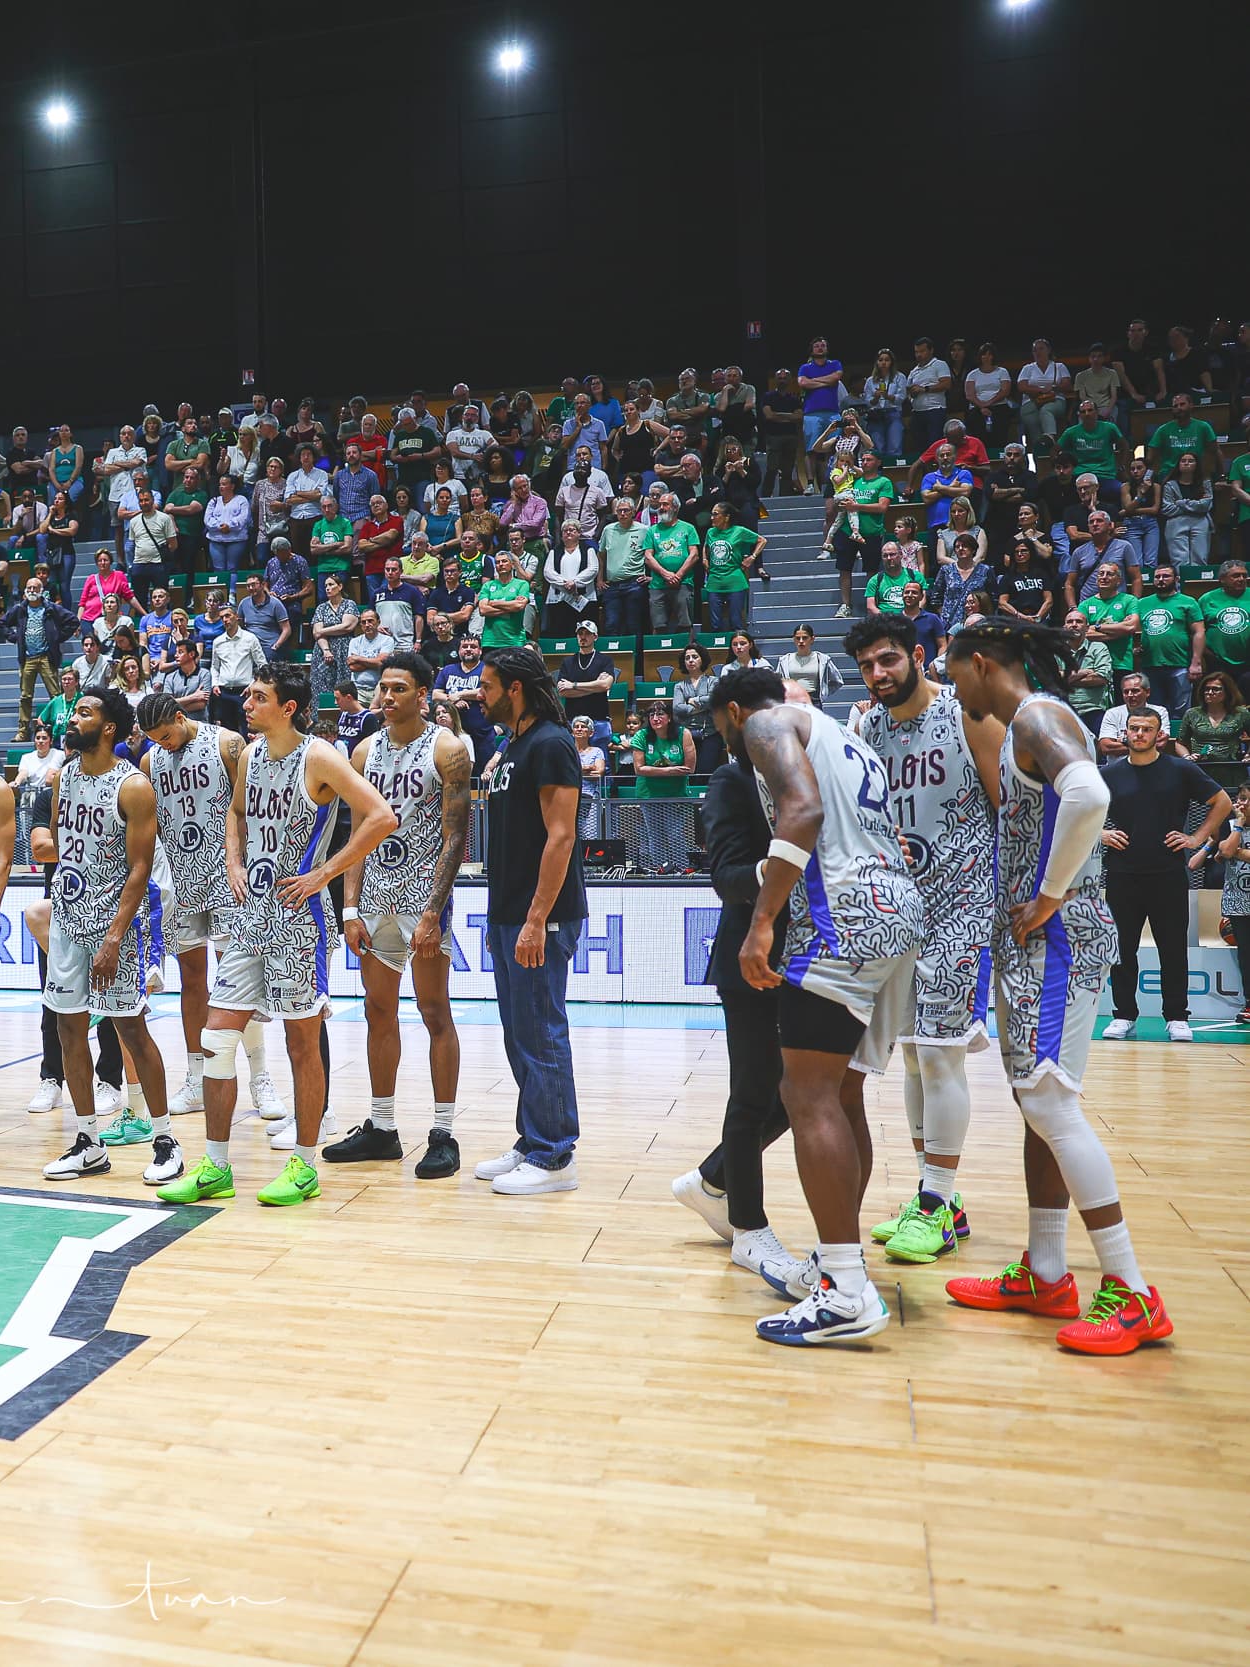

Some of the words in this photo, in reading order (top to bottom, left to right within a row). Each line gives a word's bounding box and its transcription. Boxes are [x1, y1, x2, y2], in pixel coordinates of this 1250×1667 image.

[375, 593, 386, 602] 12
[177, 795, 196, 818] 13
[893, 794, 916, 828] 11
[61, 835, 85, 864] 29
[260, 825, 278, 853] 10
